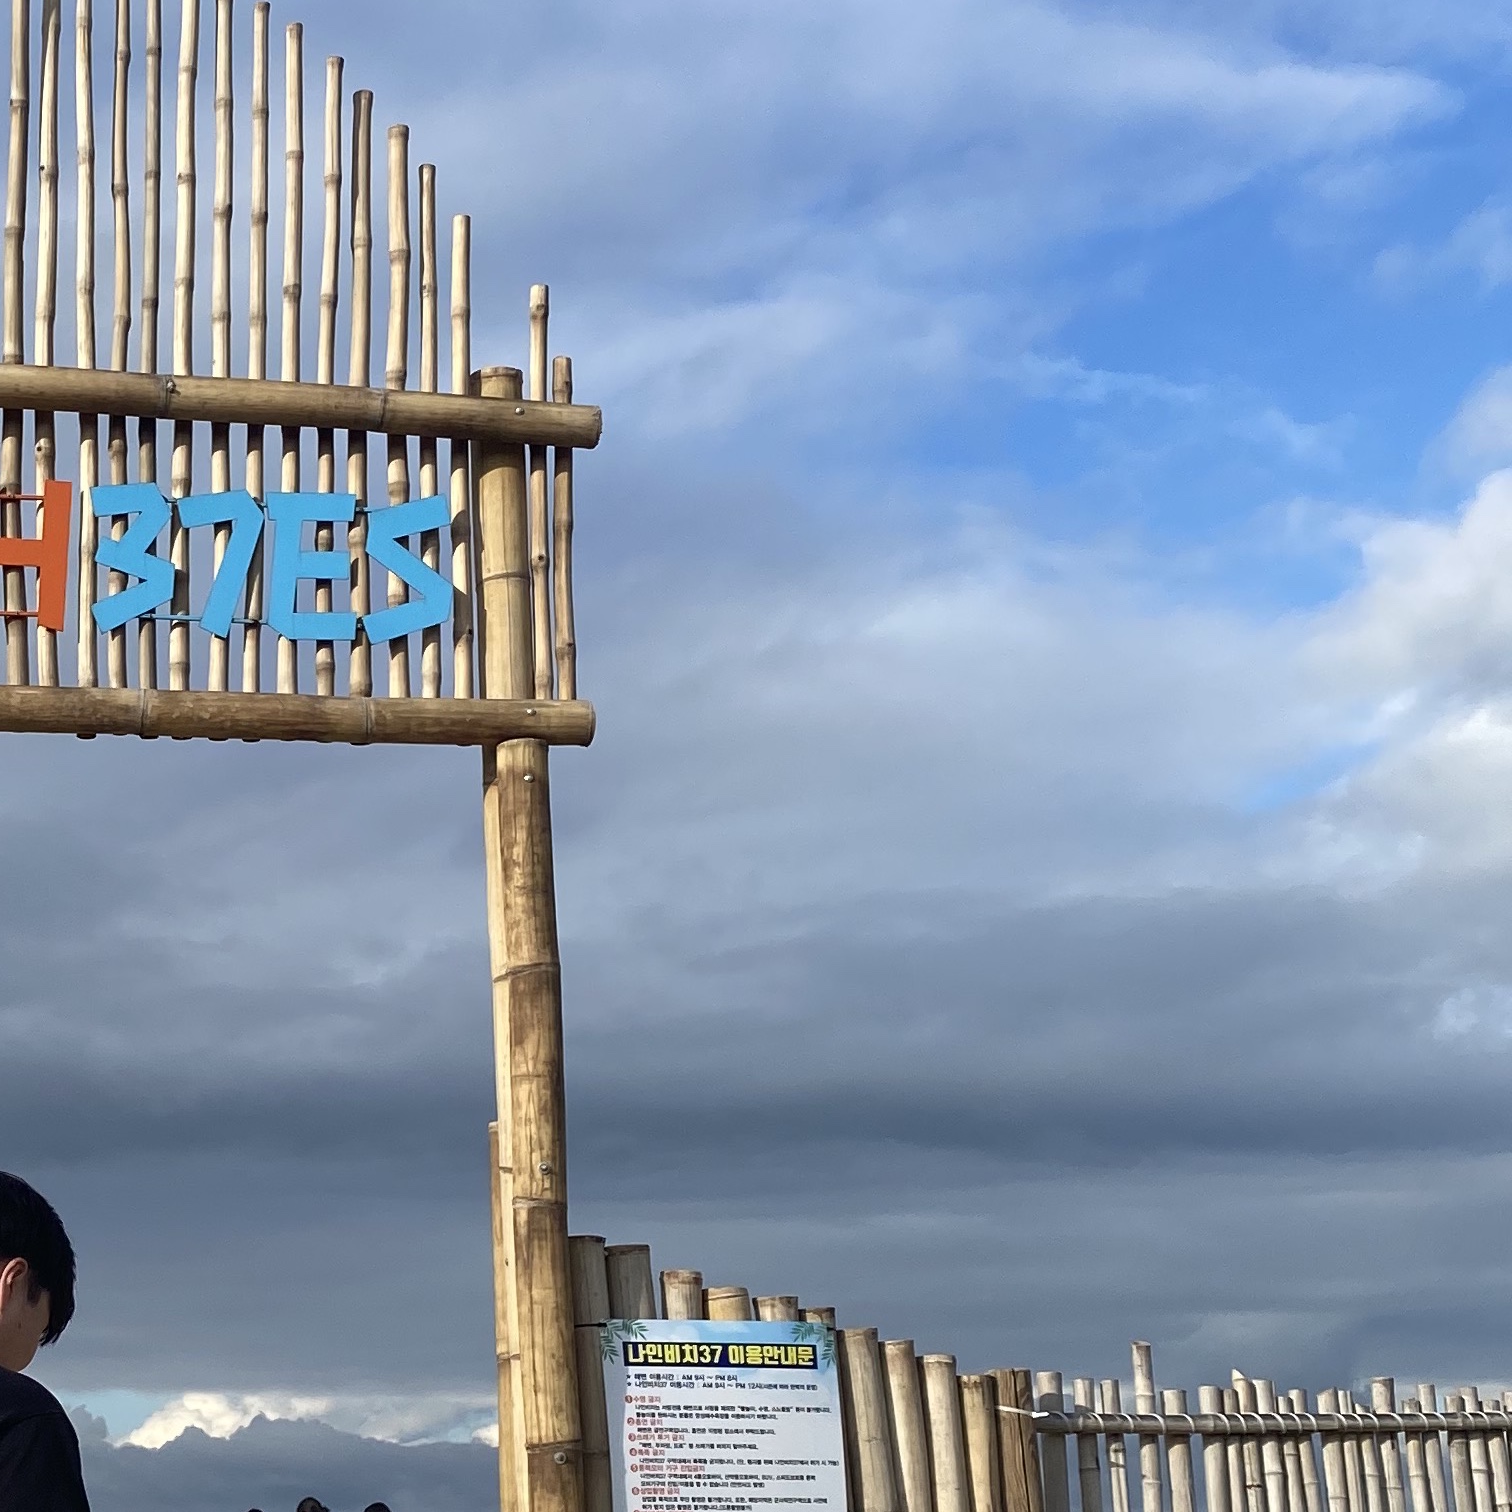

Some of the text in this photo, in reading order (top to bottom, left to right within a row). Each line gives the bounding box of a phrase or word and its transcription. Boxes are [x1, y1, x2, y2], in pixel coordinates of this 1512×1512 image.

[90, 482, 453, 644] 37ES
[628, 1344, 814, 1366] 나인비치37 이용안내문
